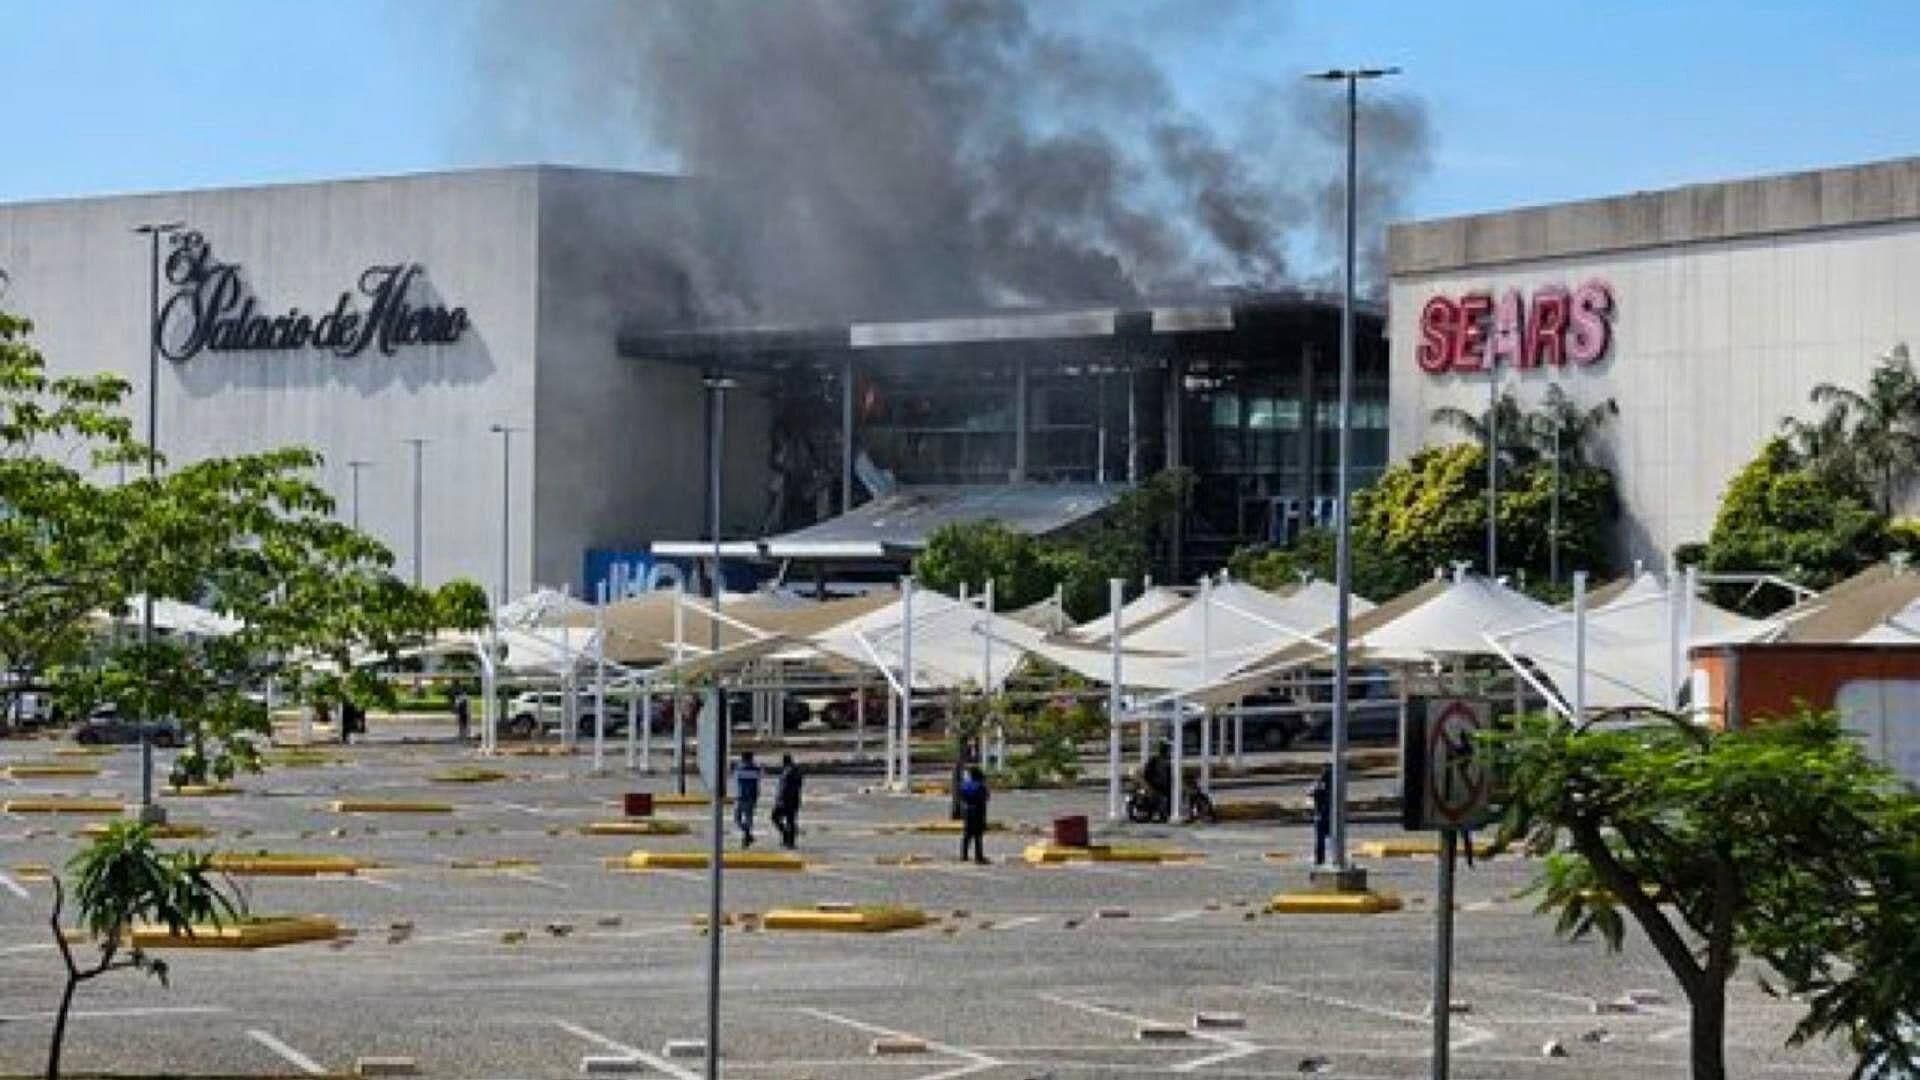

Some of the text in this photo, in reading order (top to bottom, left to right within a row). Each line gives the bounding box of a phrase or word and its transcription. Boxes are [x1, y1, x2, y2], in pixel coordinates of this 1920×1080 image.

[158, 230, 469, 361] El Palacio de Hierro
[1416, 279, 1614, 375] SEARS
